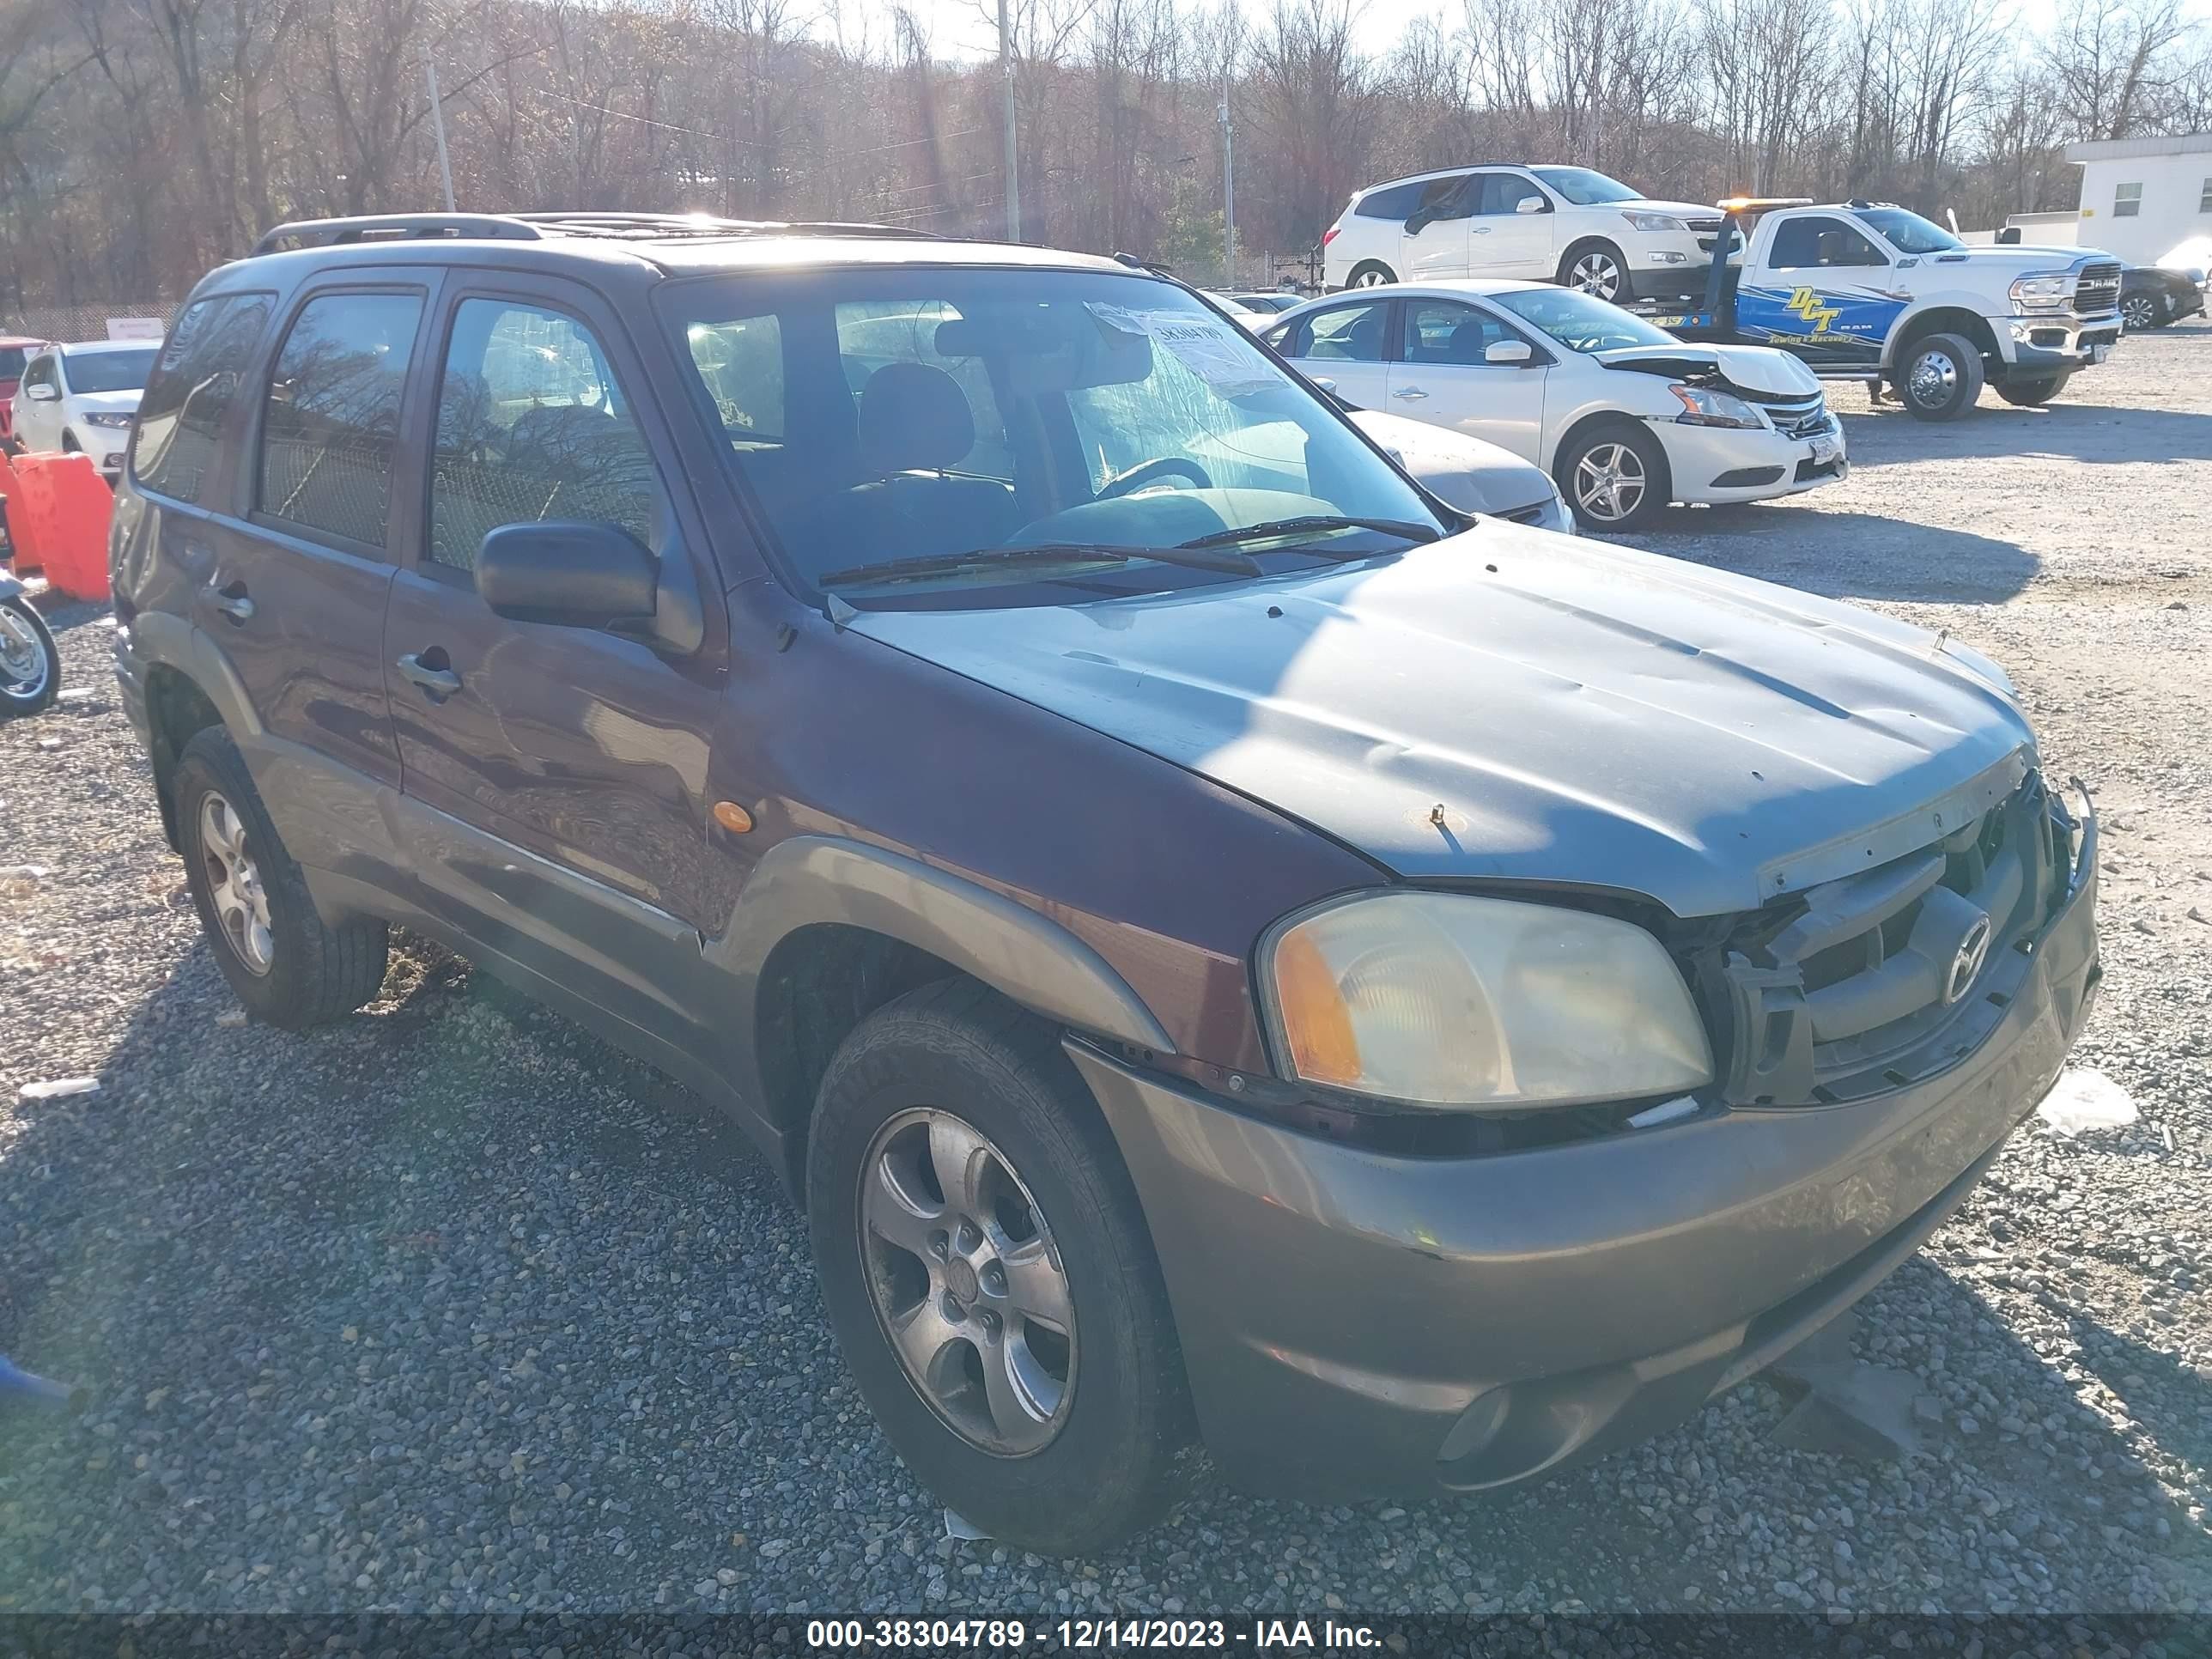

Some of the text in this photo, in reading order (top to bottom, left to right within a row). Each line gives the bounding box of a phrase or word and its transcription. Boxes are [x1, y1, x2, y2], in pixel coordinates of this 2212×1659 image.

[1784, 285, 1840, 332] DCT
[1154, 325, 1224, 341] 38304789
[1769, 335, 1801, 343] Towing
[1810, 333, 1853, 343] Recovery
